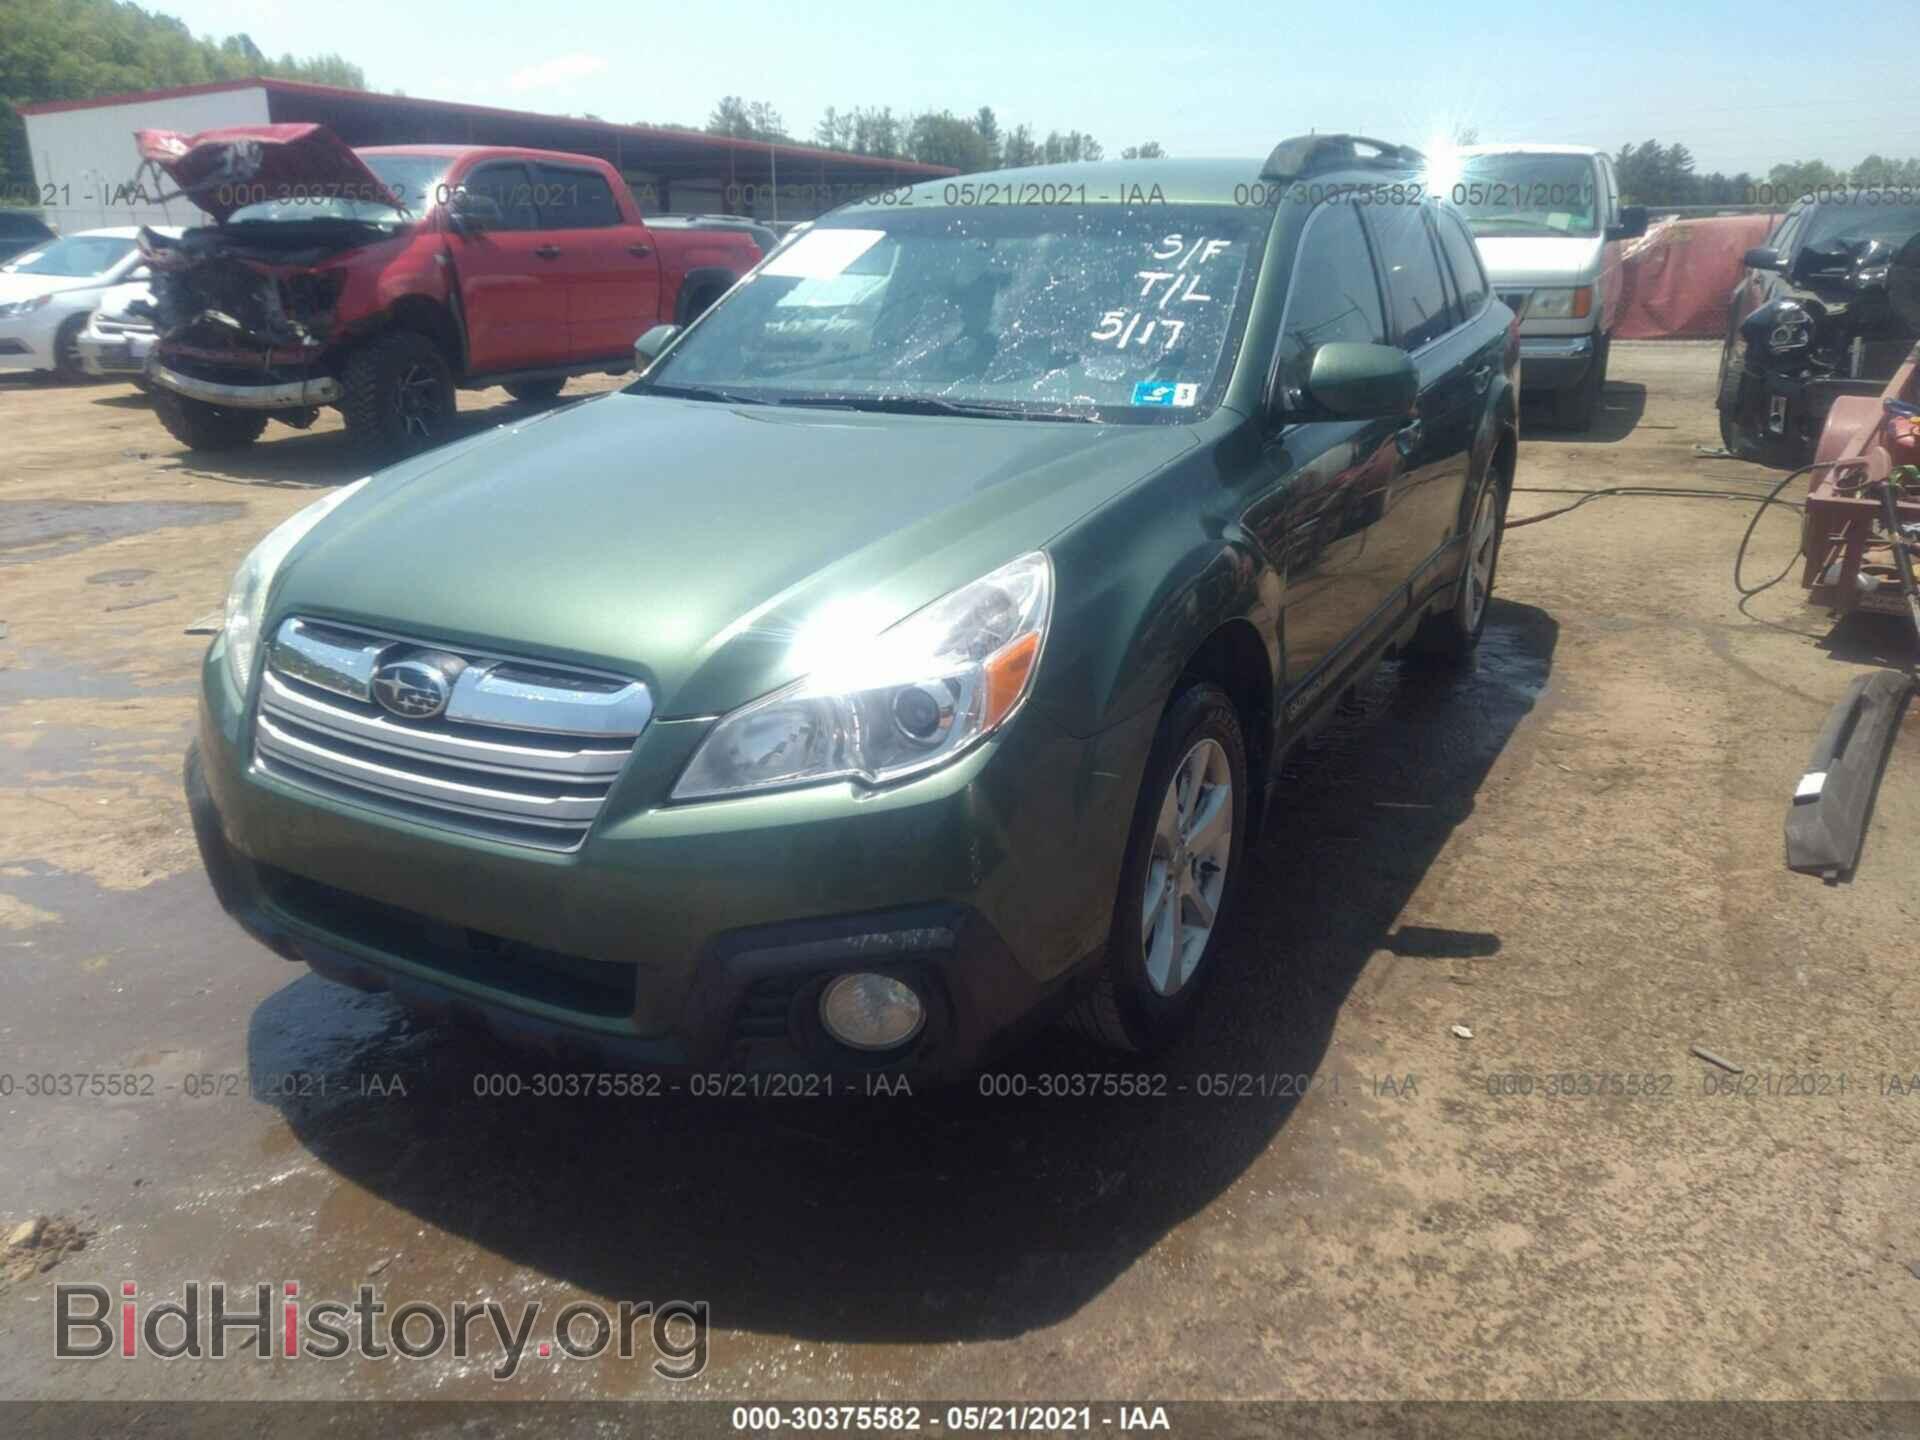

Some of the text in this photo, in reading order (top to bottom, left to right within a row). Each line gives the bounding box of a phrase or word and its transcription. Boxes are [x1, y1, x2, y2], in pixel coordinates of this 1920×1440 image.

[1152, 234, 1232, 270] S/F
[1136, 271, 1212, 309] T/L
[1090, 311, 1185, 349] 5/17
